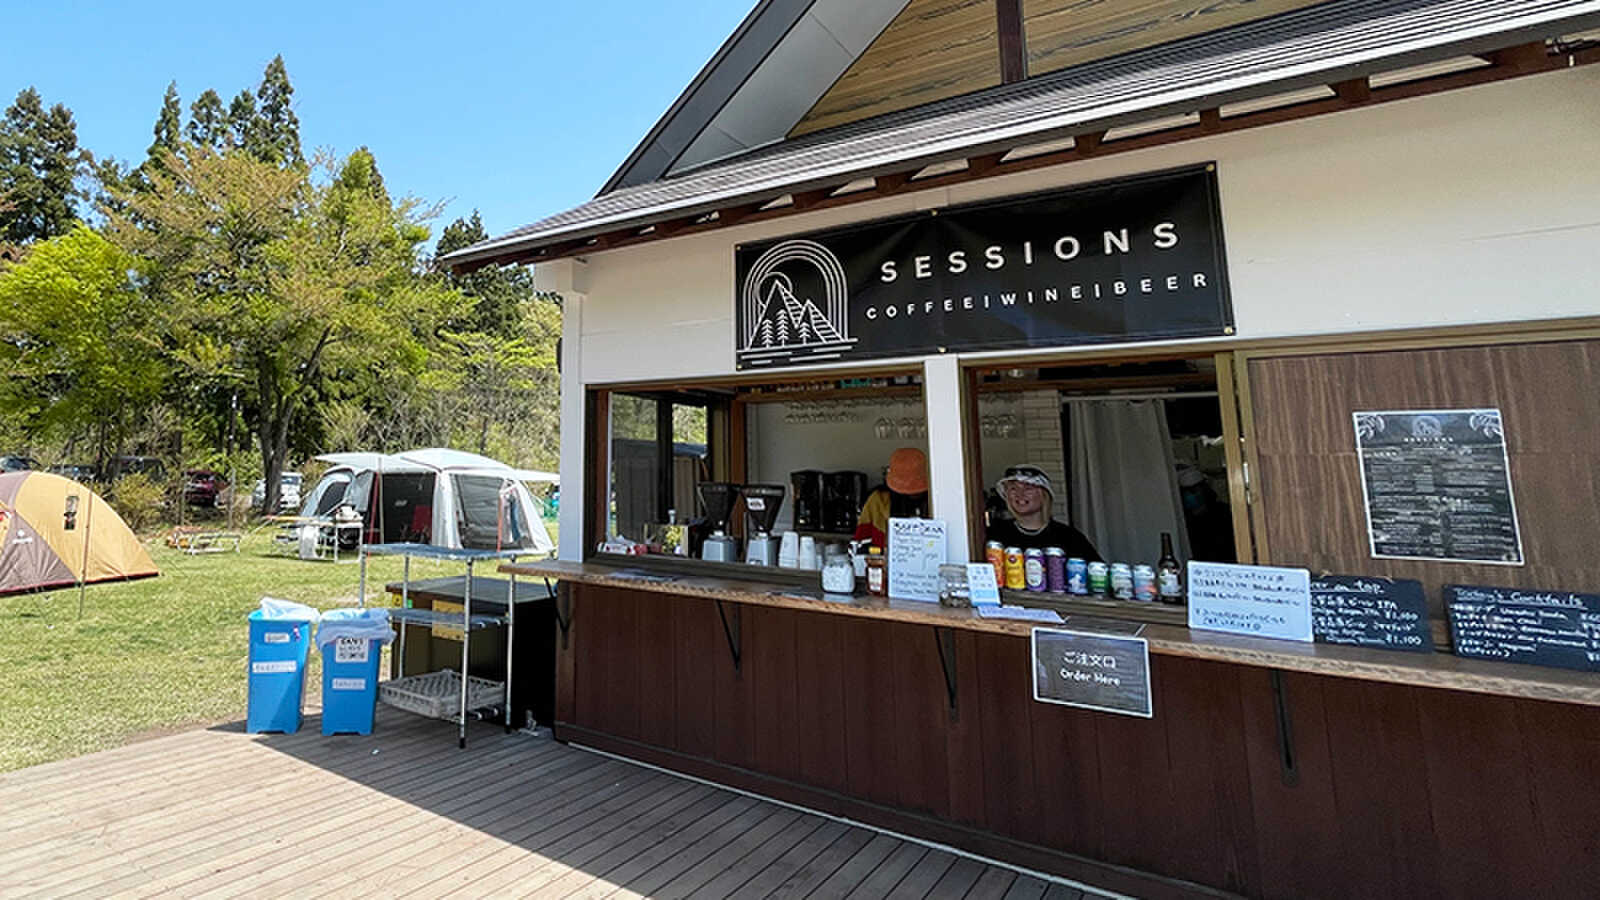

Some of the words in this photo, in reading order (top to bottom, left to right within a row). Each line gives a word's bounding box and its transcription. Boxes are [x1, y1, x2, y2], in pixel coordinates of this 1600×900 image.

[880, 222, 1179, 283] SESSIONS
[1060, 669, 1090, 682] Order
[1093, 672, 1121, 688] Here
